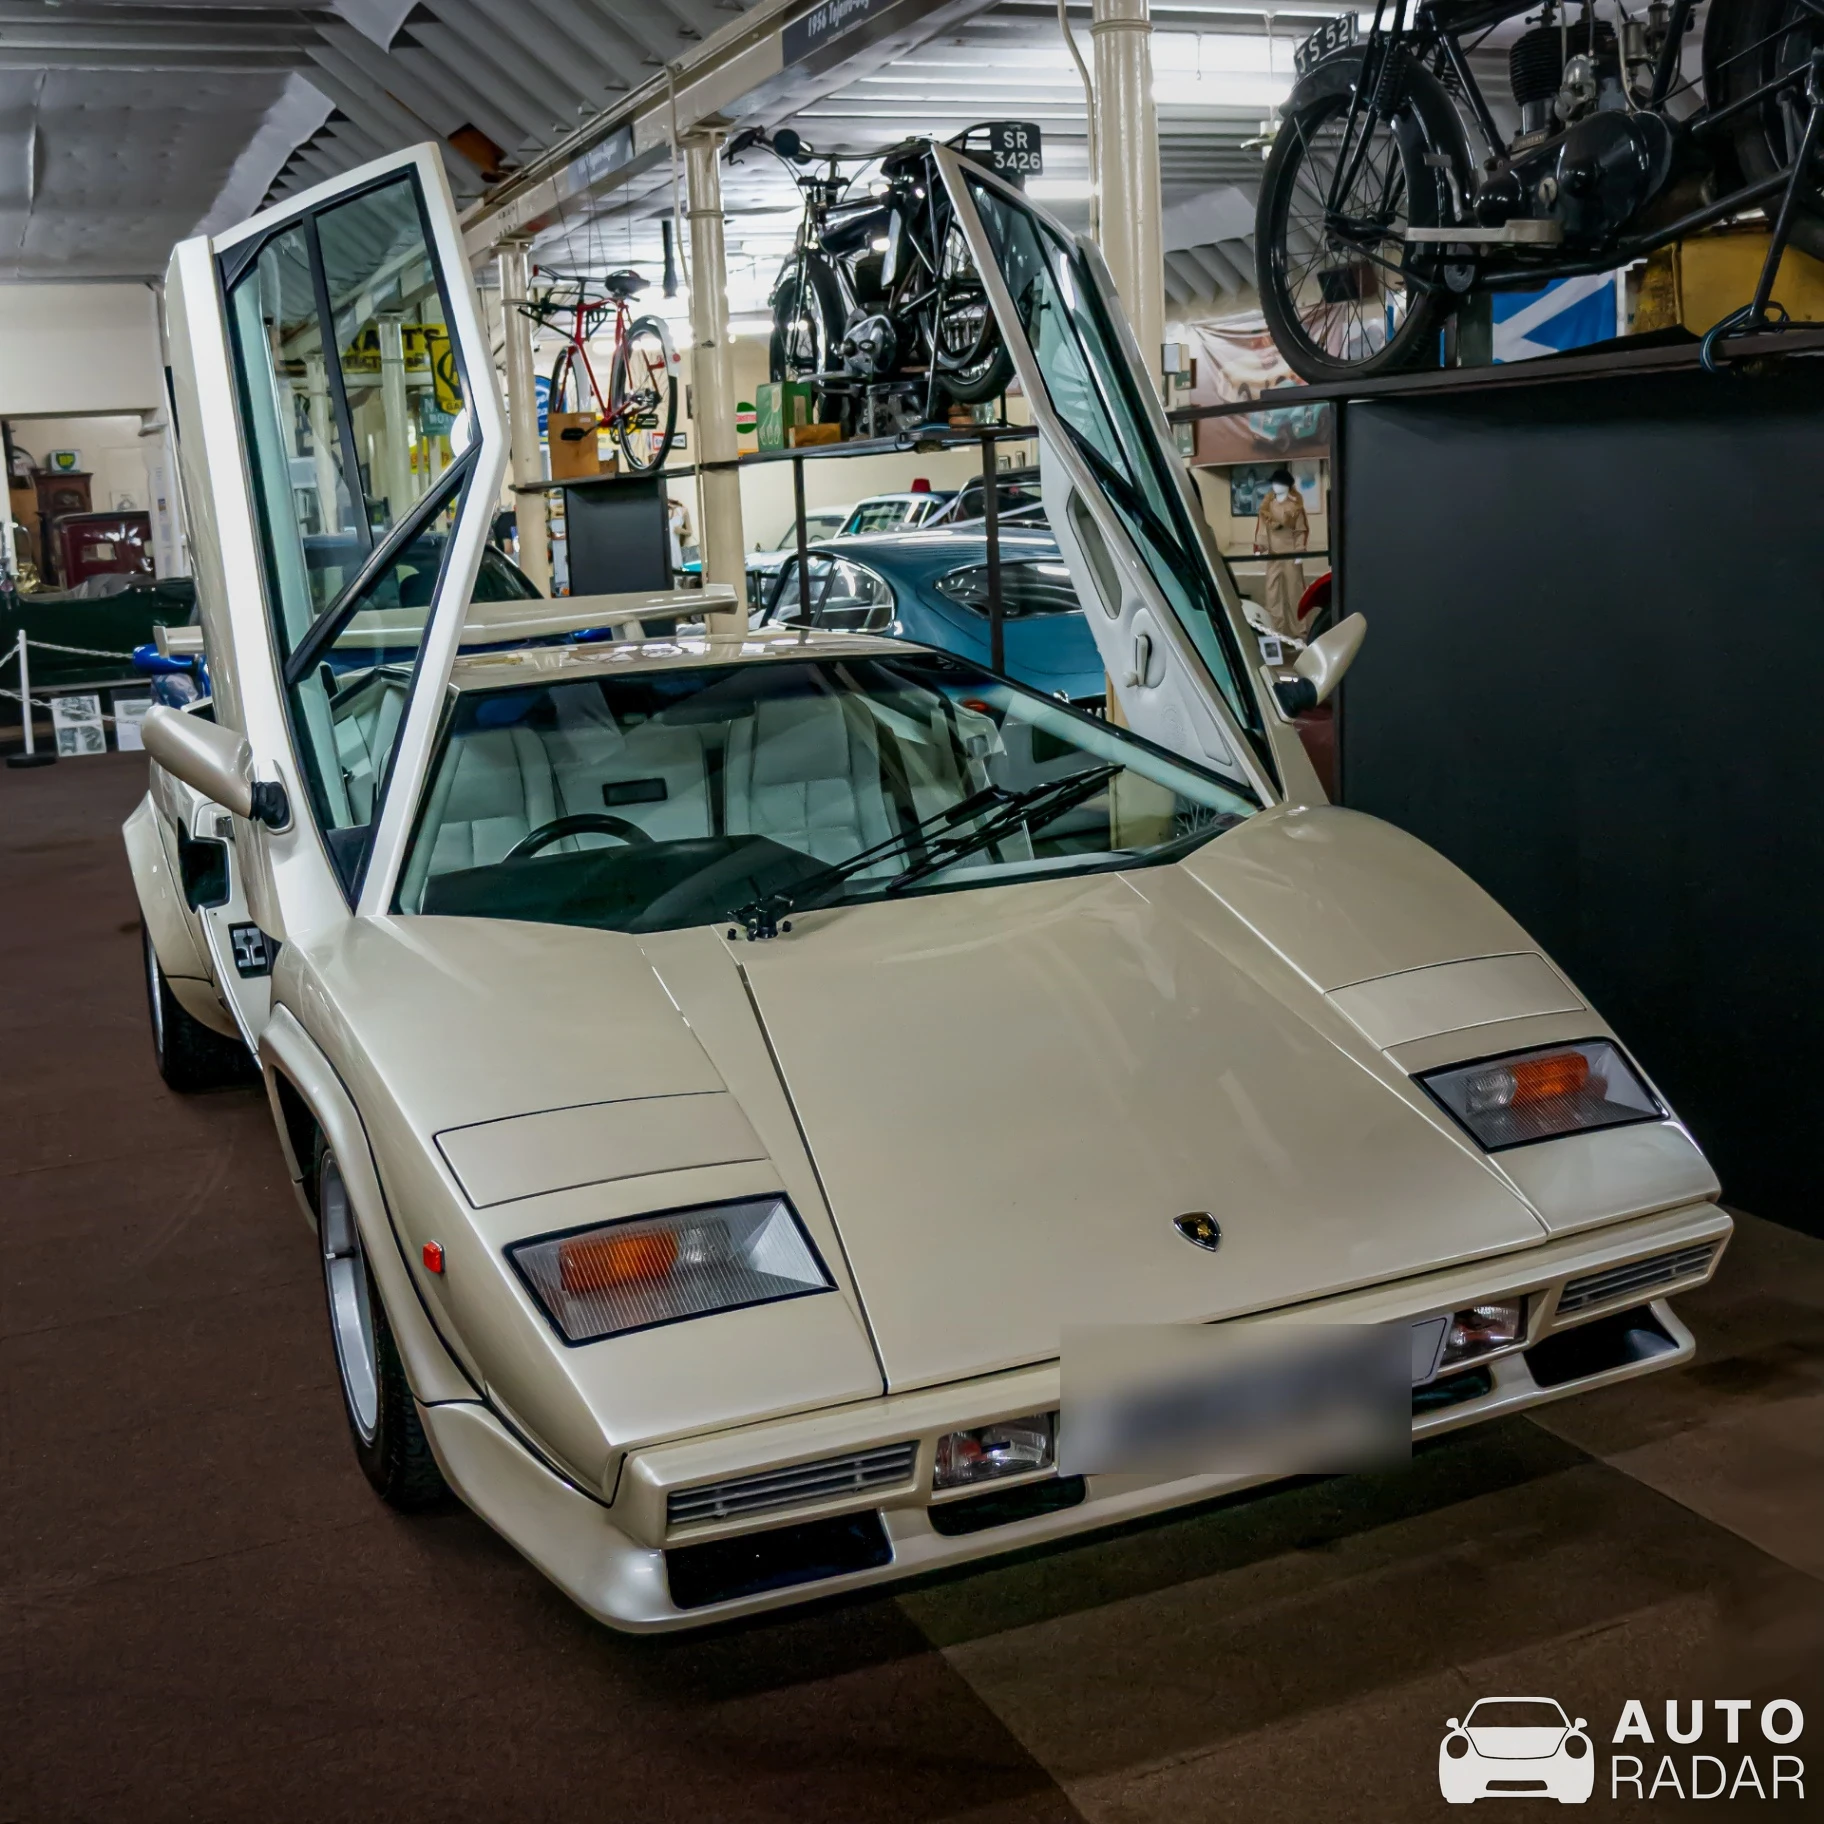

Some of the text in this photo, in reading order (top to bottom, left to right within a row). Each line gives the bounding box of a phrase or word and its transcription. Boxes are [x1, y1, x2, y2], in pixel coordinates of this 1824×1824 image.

[808, 8, 827, 37] 1956
[1326, 15, 1355, 49] 521
[1003, 131, 1028, 148] SR
[993, 151, 1040, 169] 3426
